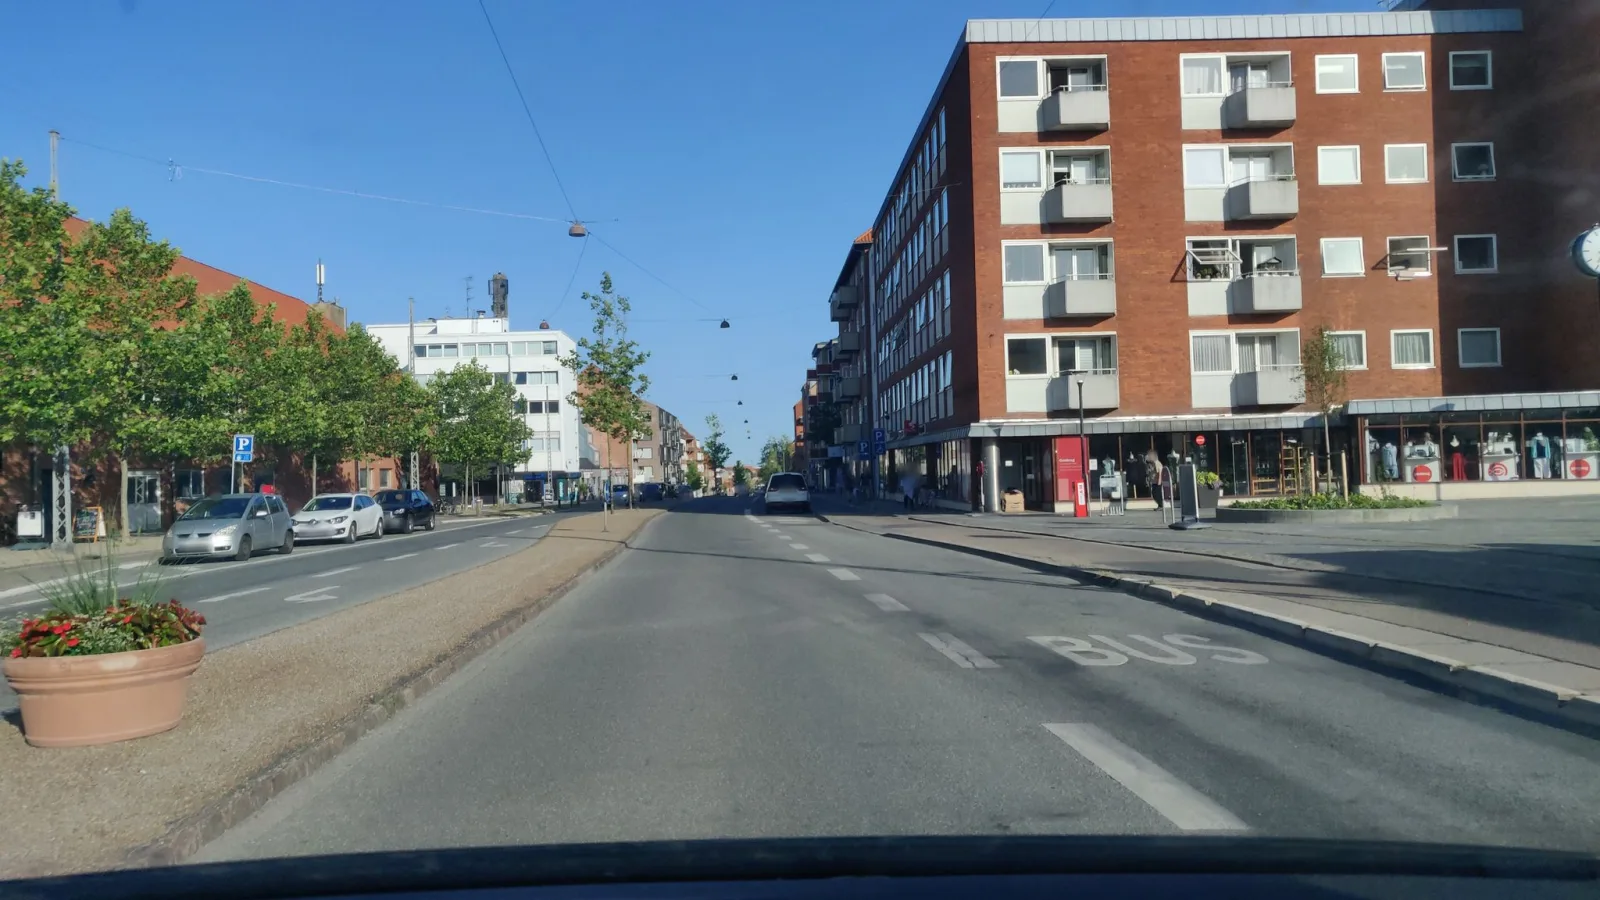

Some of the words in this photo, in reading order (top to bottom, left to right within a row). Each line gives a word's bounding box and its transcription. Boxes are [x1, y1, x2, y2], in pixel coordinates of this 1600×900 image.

[876, 431, 883, 441] P
[238, 437, 250, 451] P
[860, 442, 868, 452] P
[1025, 634, 1269, 666] BUS
